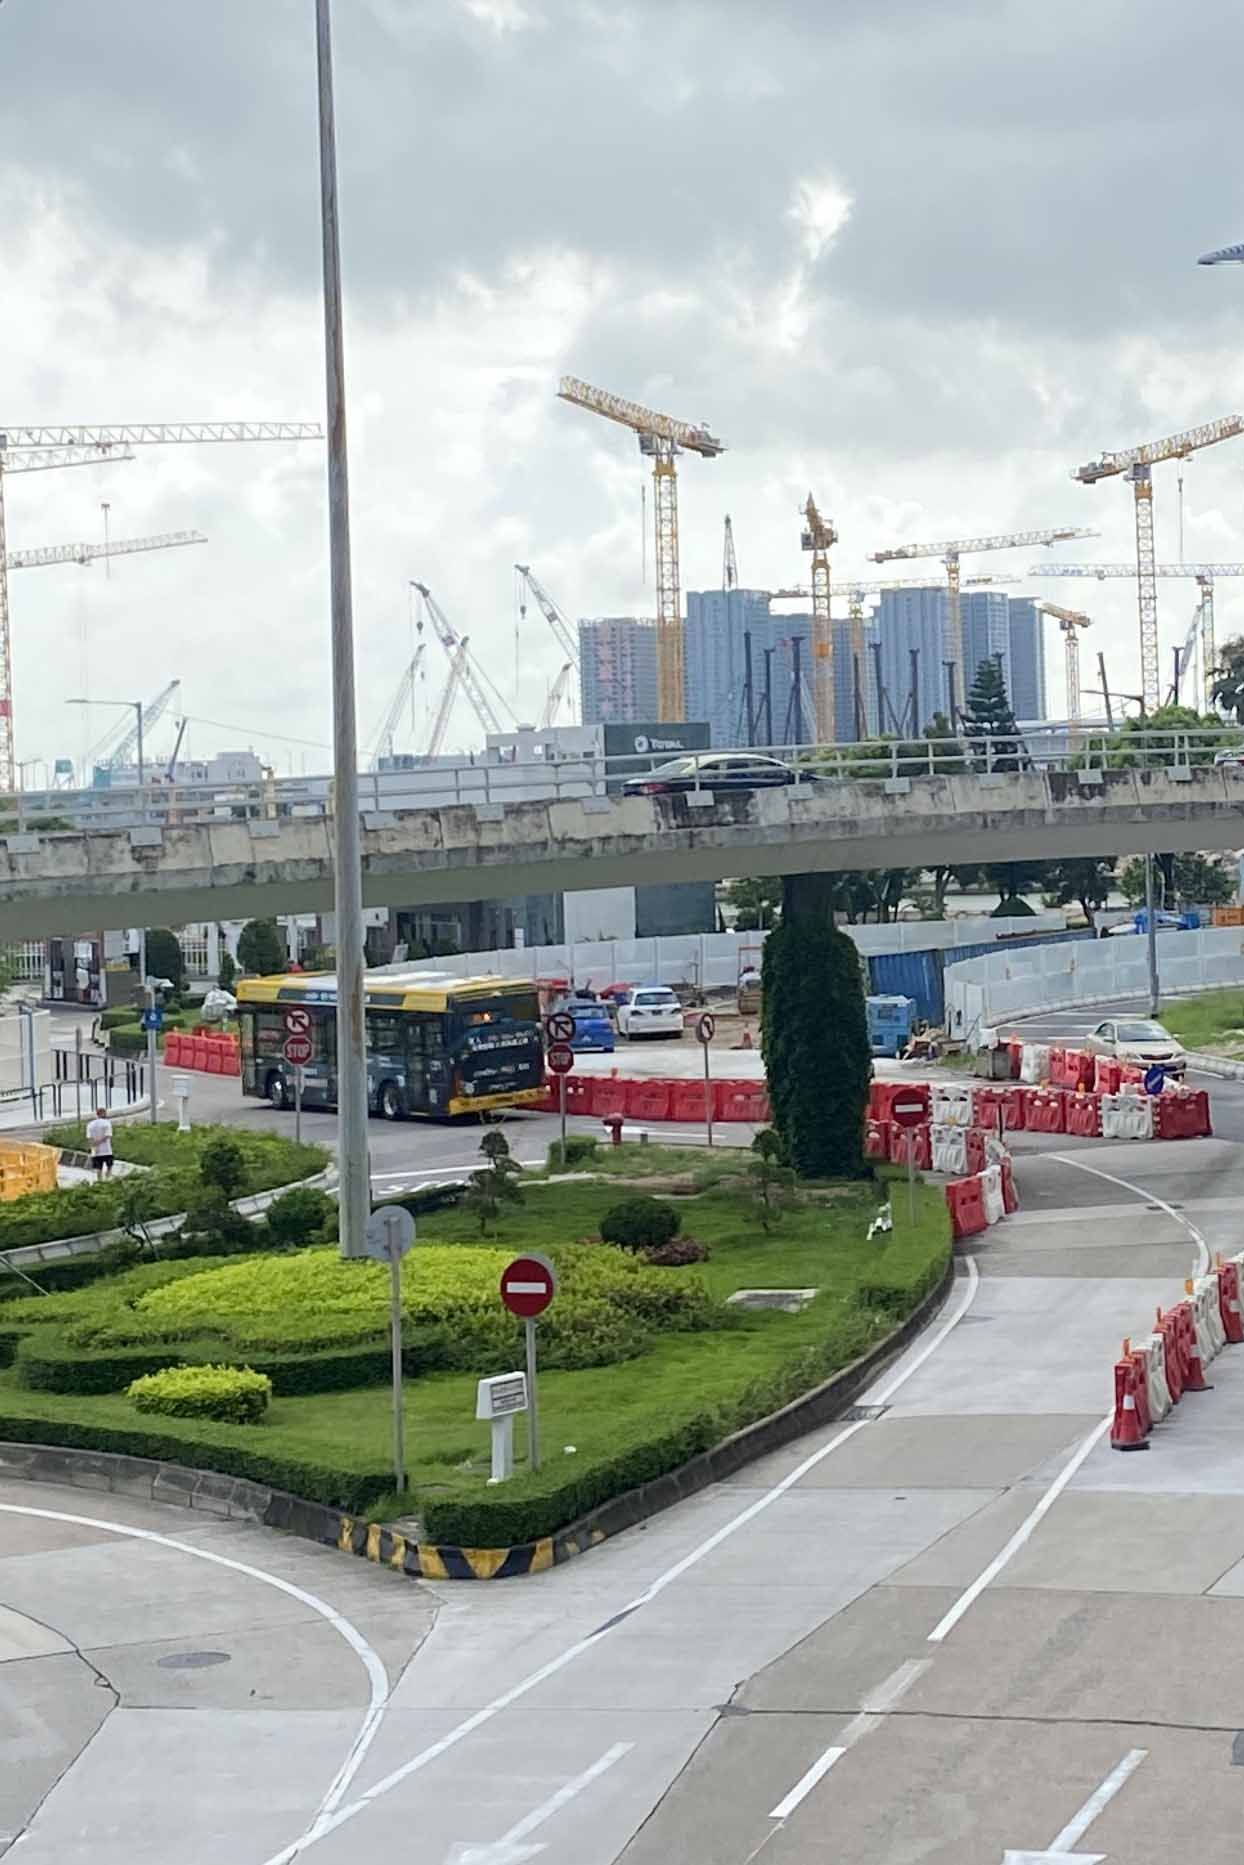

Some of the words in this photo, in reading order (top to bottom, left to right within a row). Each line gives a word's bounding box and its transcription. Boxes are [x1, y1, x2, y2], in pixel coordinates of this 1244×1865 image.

[649, 738, 685, 750] TOTAL
[286, 1043, 310, 1058] STOP
[550, 1052, 571, 1065] STOP
